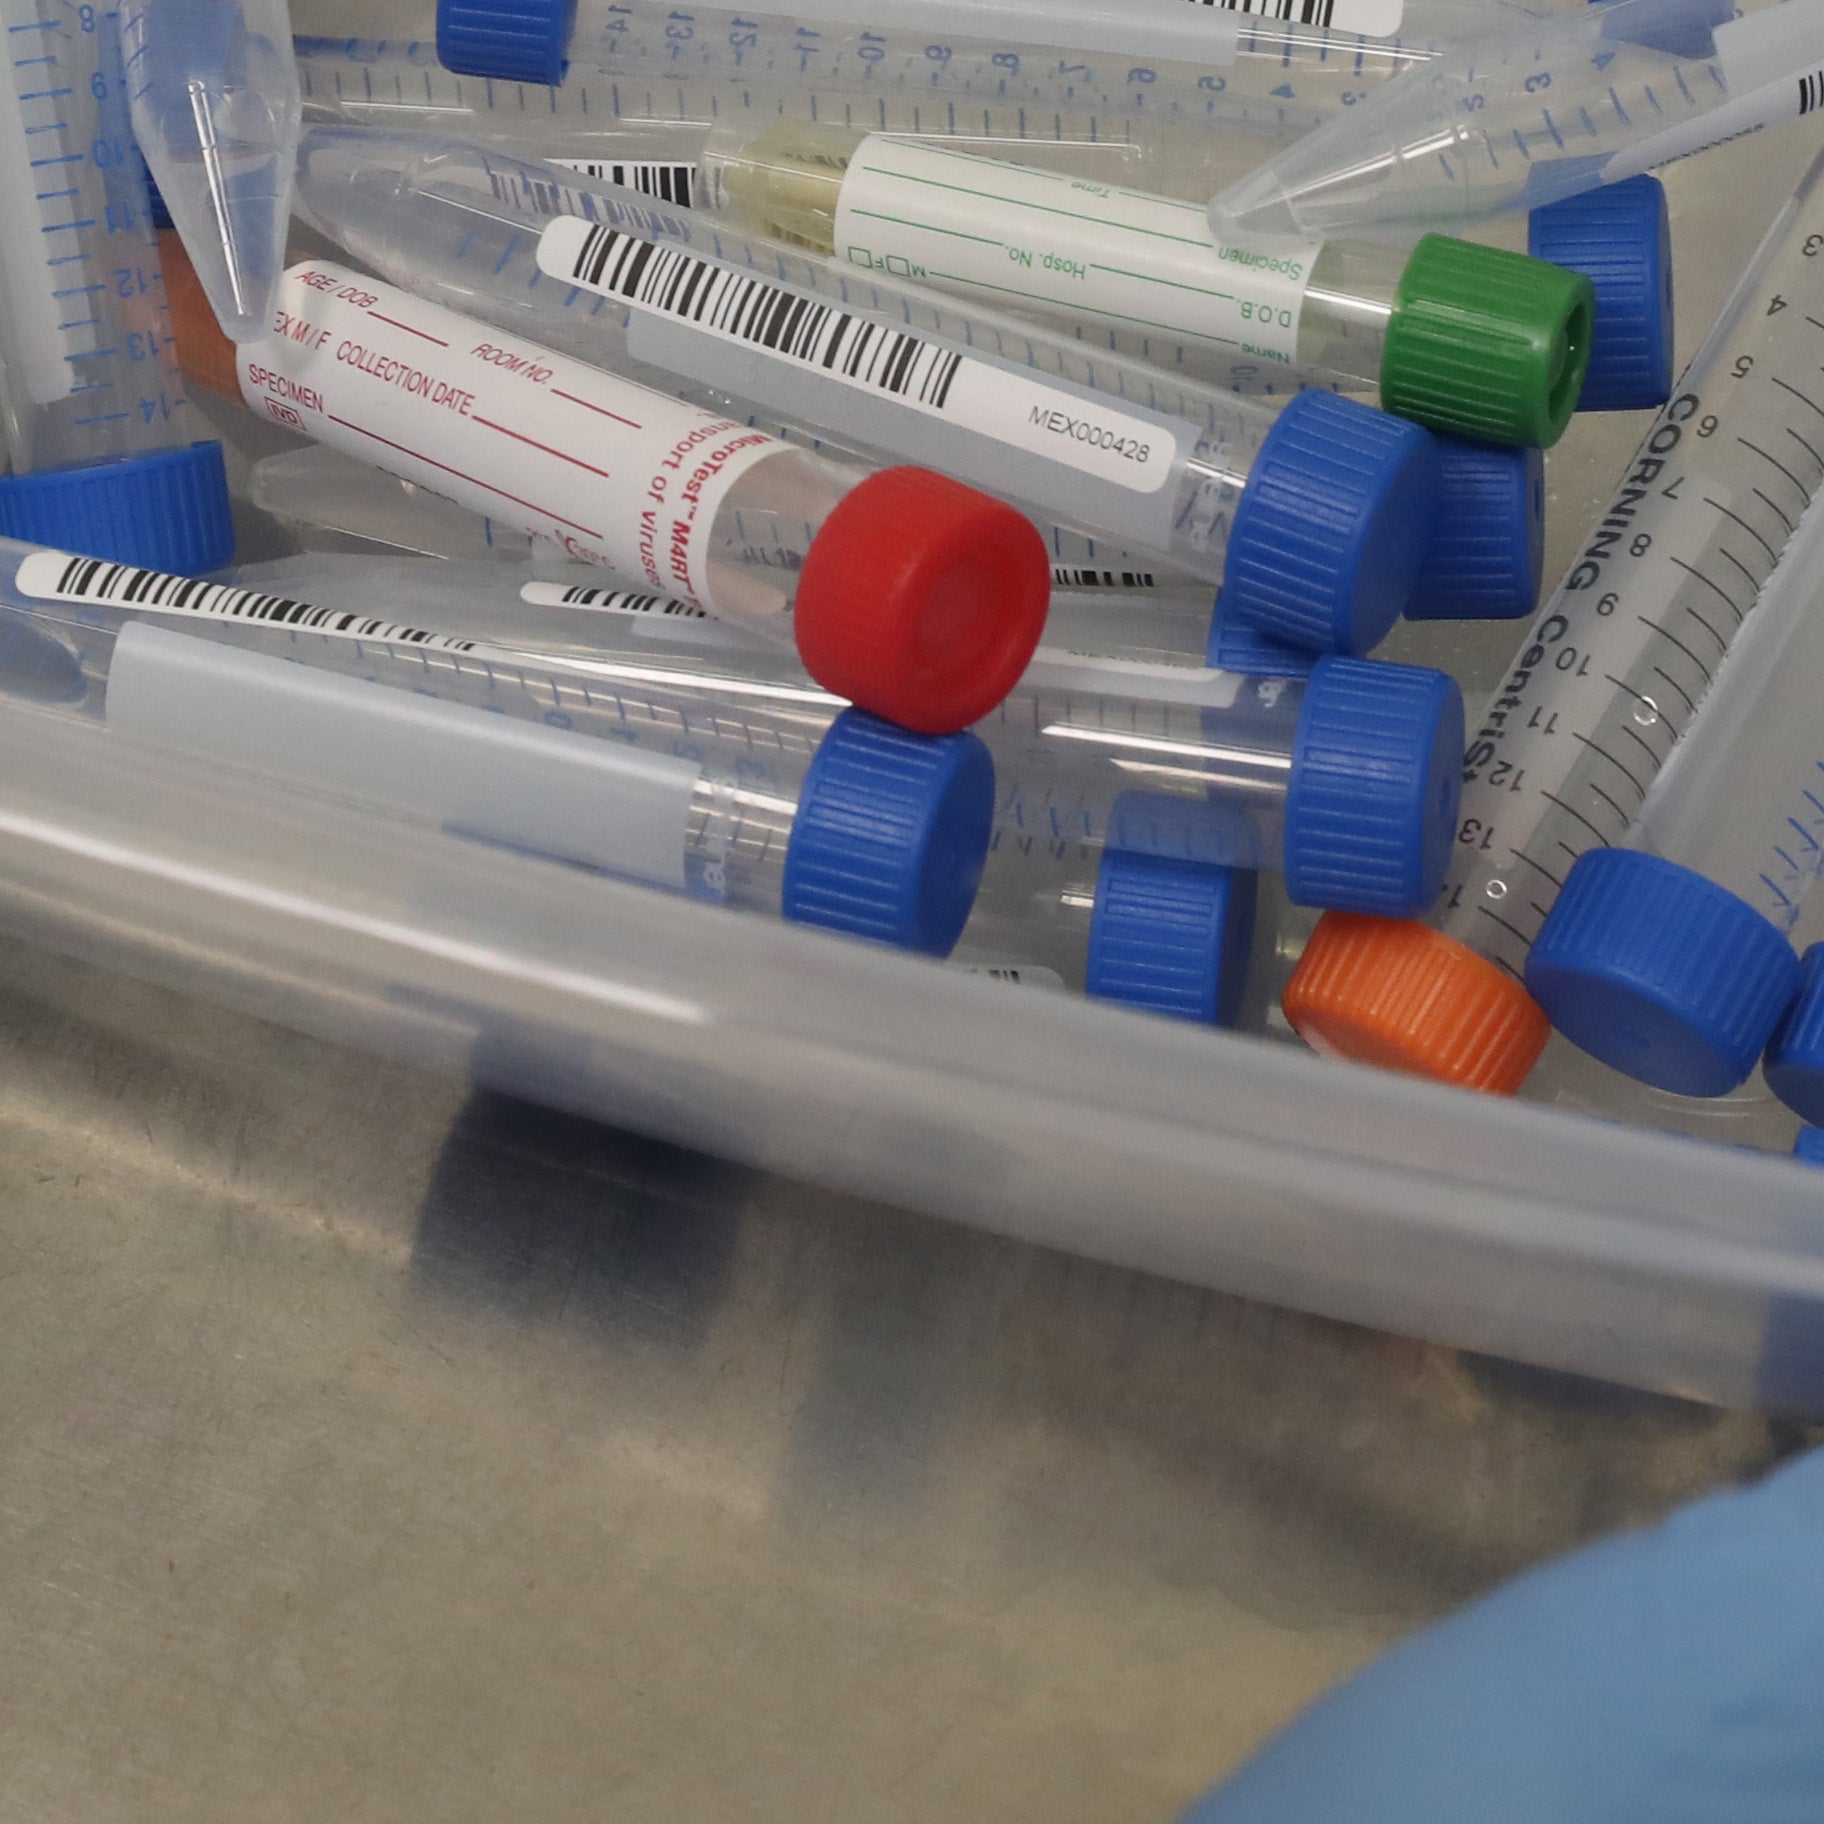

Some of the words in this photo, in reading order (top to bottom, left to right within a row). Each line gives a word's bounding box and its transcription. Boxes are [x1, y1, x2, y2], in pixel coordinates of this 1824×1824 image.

[1072, 180, 1110, 198] Time
[1002, 245, 1033, 268] No.
[1802, 234, 1824, 257] 3
[908, 263, 927, 279] M
[1038, 251, 1086, 279] Hosp.
[1218, 246, 1304, 282] Specimen
[1766, 295, 1788, 316] 4
[471, 343, 523, 373] ROOM
[525, 364, 553, 384] NO.
[1241, 342, 1290, 364] Name
[336, 341, 434, 397] COLLECTION
[432, 381, 475, 416] DATE
[1730, 355, 1754, 378] 5
[248, 363, 324, 413] SPECIMEN
[271, 406, 297, 424] IVD
[1696, 415, 1719, 438] 6
[1028, 405, 1152, 463] MEX000428
[648, 475, 668, 504] of
[1565, 393, 1700, 591] CORNING
[1661, 477, 1685, 500] 7
[1630, 534, 1653, 557] 8
[1597, 592, 1620, 616] 9
[1555, 647, 1592, 677] 10
[1526, 706, 1559, 734] 11
[1488, 759, 1527, 791] 12
[1459, 819, 1496, 851] 13
